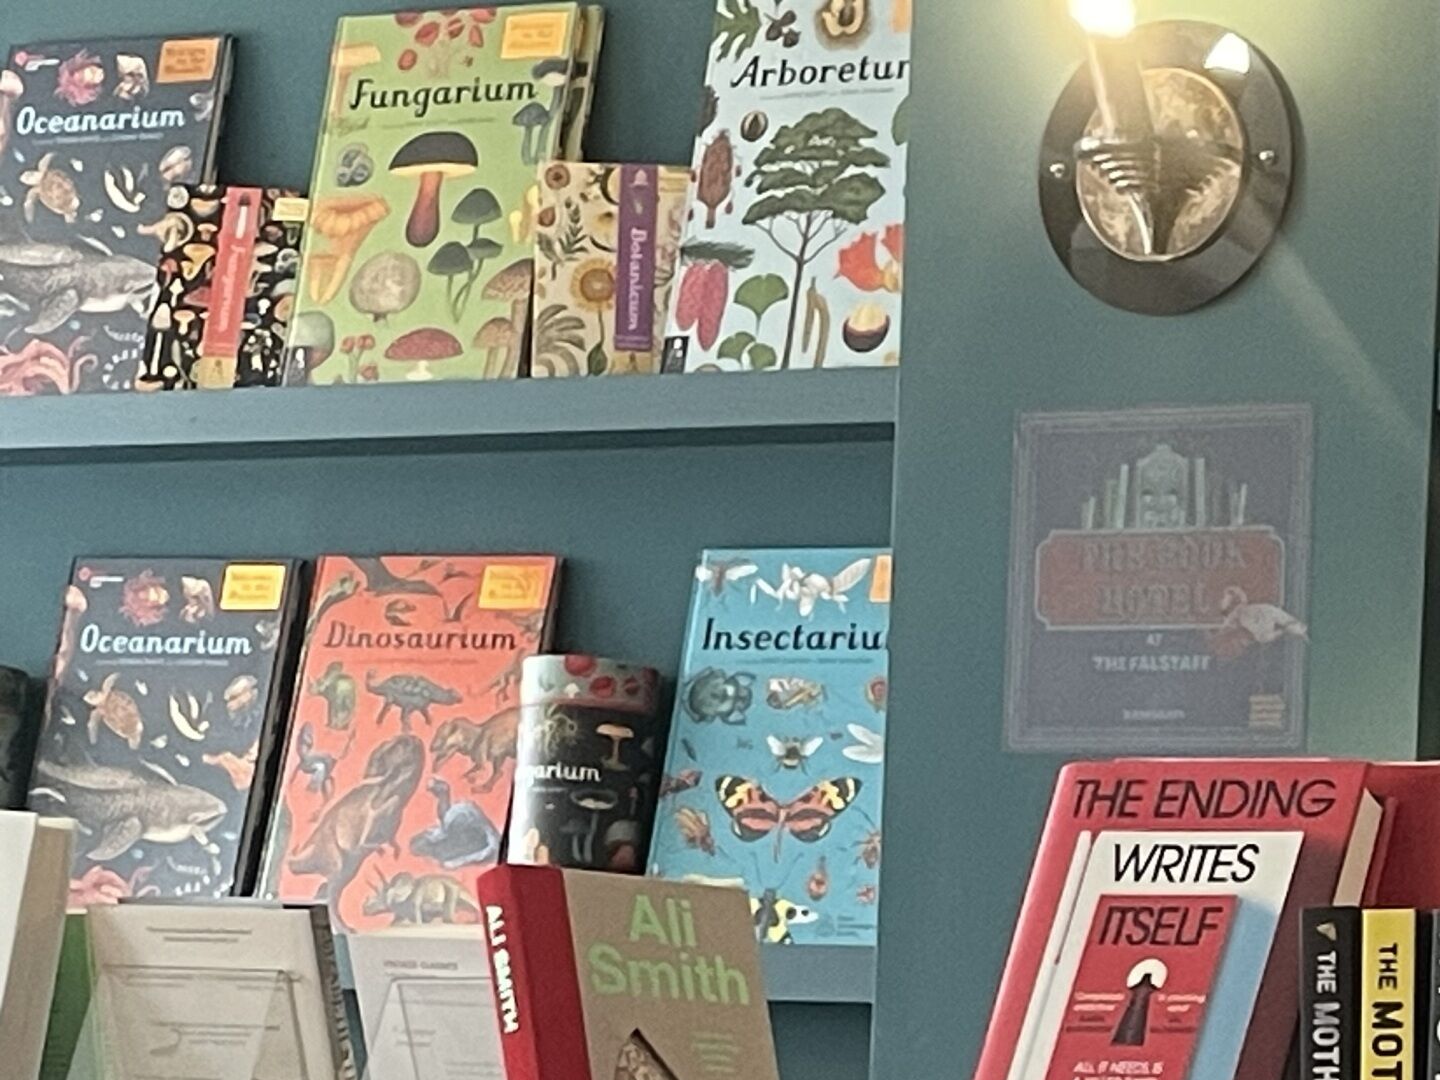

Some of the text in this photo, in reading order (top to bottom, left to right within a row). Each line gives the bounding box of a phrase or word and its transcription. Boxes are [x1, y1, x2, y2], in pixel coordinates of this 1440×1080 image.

[349, 77, 537, 118] Fungarium
[16, 106, 185, 137] Oceanarium
[79, 624, 252, 657] Oceanarium
[323, 620, 517, 651] Dinosaurium
[702, 617, 887, 652] Insectariu
[1072, 778, 1337, 820] THE ENDING
[1113, 843, 1259, 884] WRITES
[629, 894, 698, 948] Ali
[1099, 905, 1224, 947] ITSELF
[586, 943, 751, 1005] Smith
[1315, 950, 1337, 994] THE
[1378, 943, 1398, 990] THE
